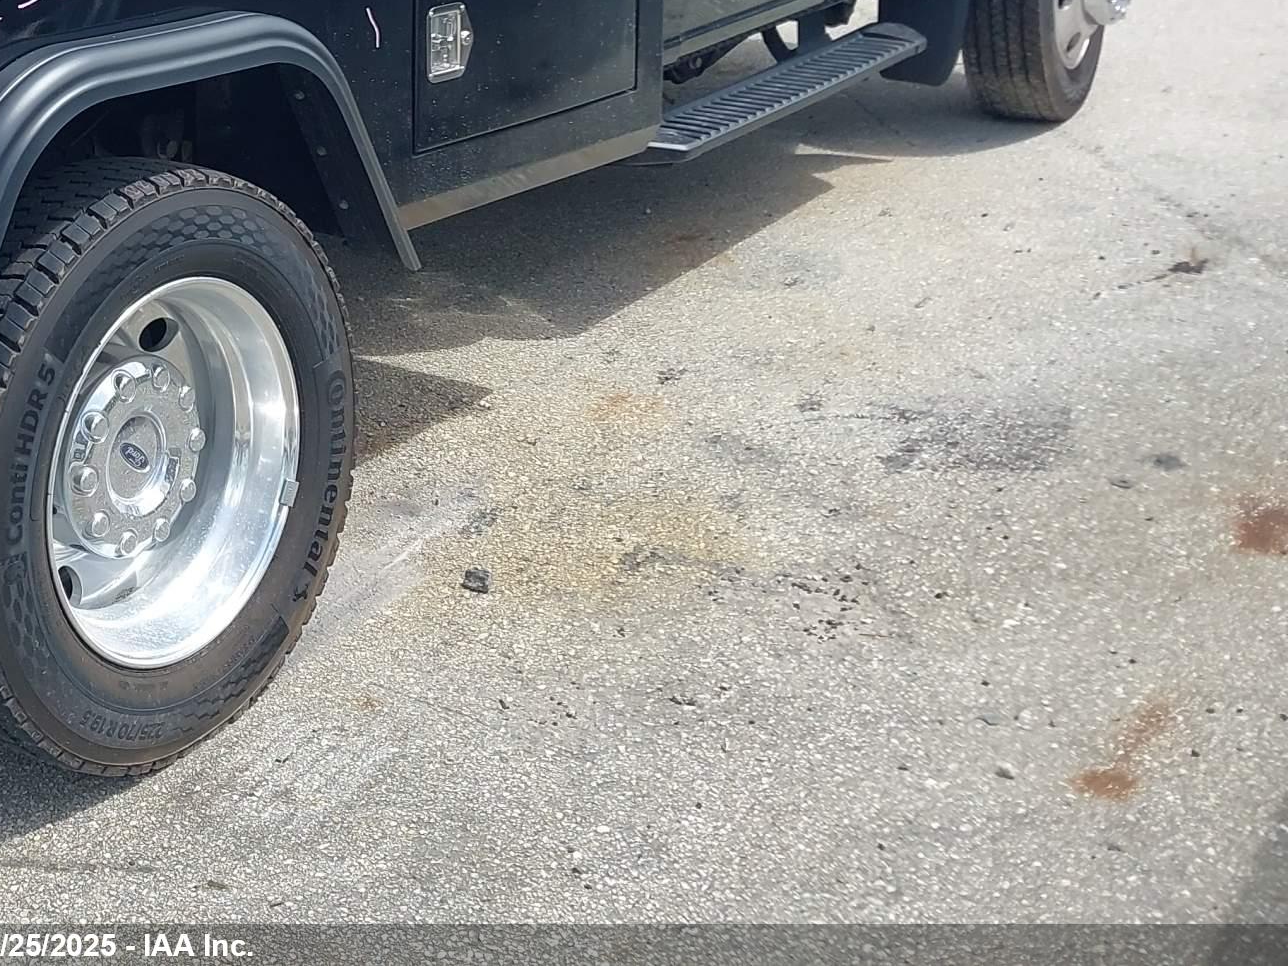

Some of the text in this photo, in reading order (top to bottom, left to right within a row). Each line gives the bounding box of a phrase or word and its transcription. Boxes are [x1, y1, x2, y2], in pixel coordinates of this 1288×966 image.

[123, 445, 147, 469] Ford
[304, 370, 347, 578] Continental
[6, 463, 29, 546] Conti
